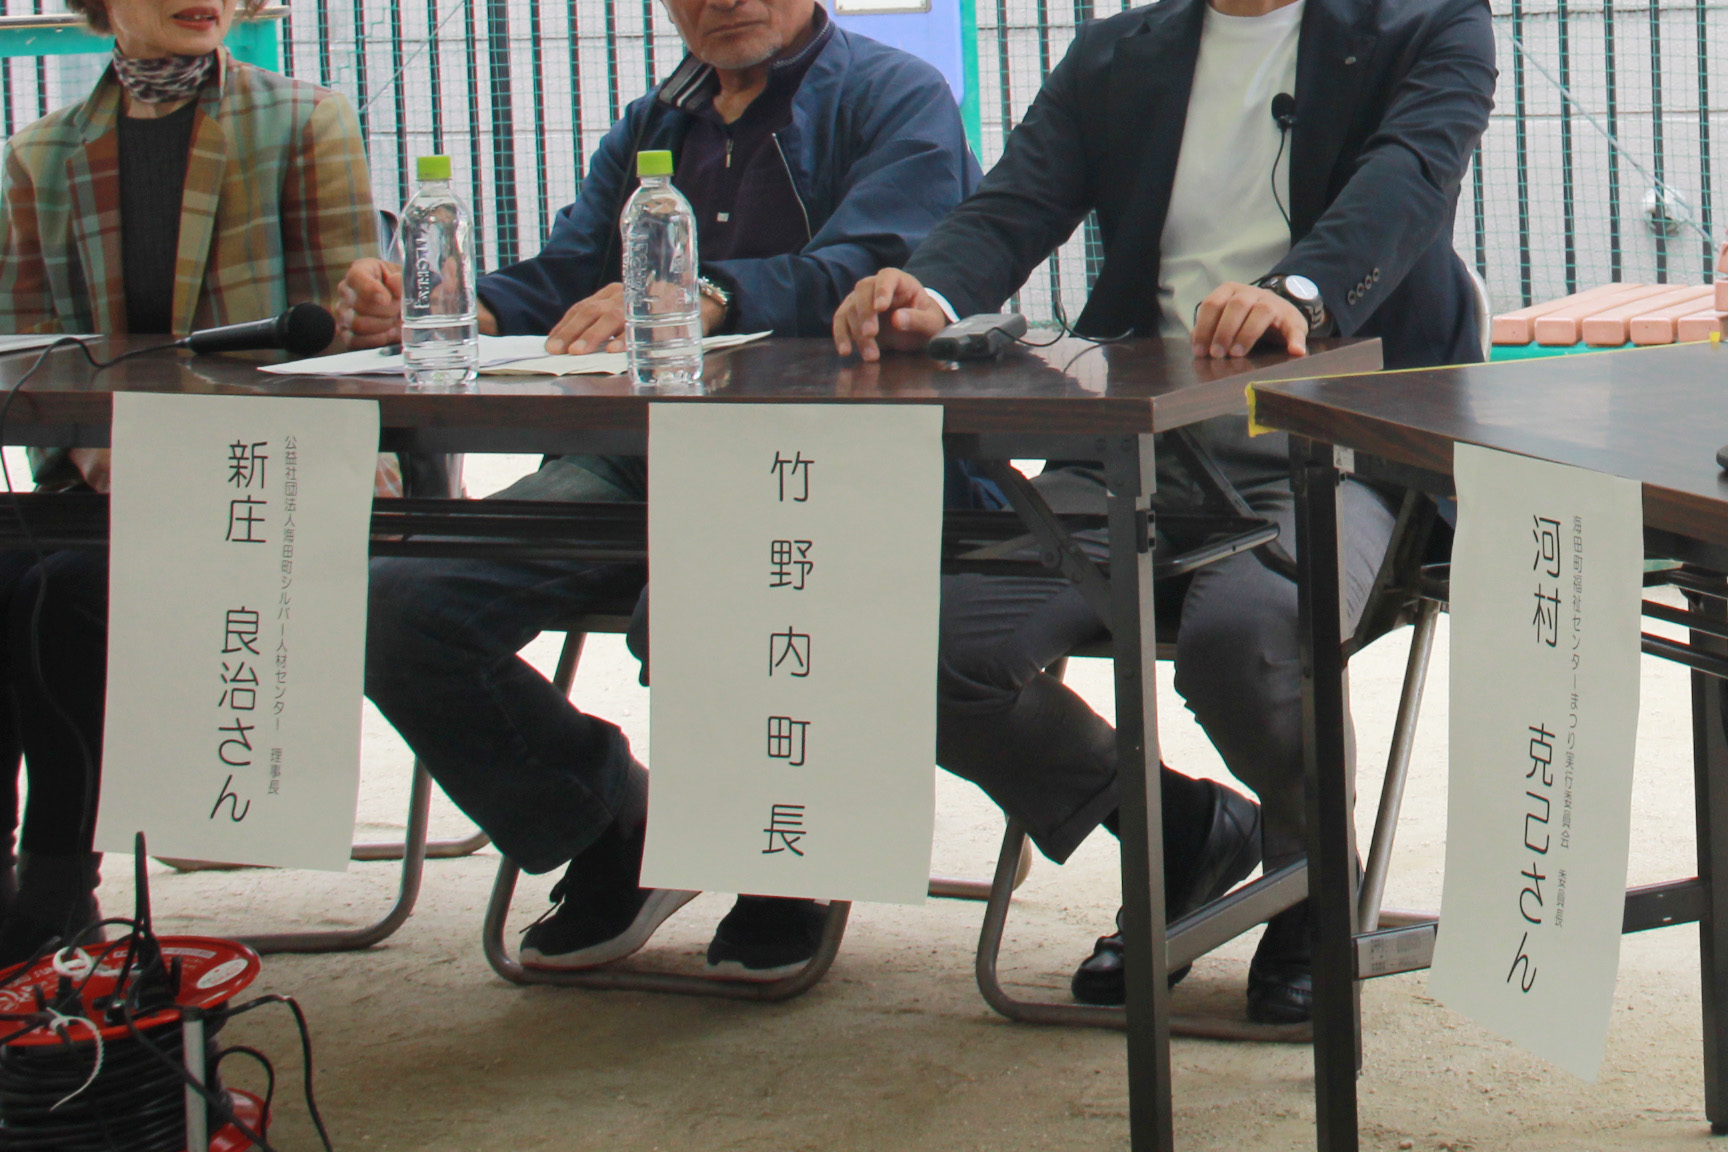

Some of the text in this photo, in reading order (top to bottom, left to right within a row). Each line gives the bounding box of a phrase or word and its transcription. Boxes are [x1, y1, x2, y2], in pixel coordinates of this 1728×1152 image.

[209, 439, 269, 822] 新庄 良治さん
[267, 435, 298, 795] 公益社団法人海田町シルバー人材センター 理事長
[762, 450, 815, 857] 竹野内町長
[1506, 514, 1562, 993] 河村 克己さん
[1554, 868, 1568, 928] 委員長
